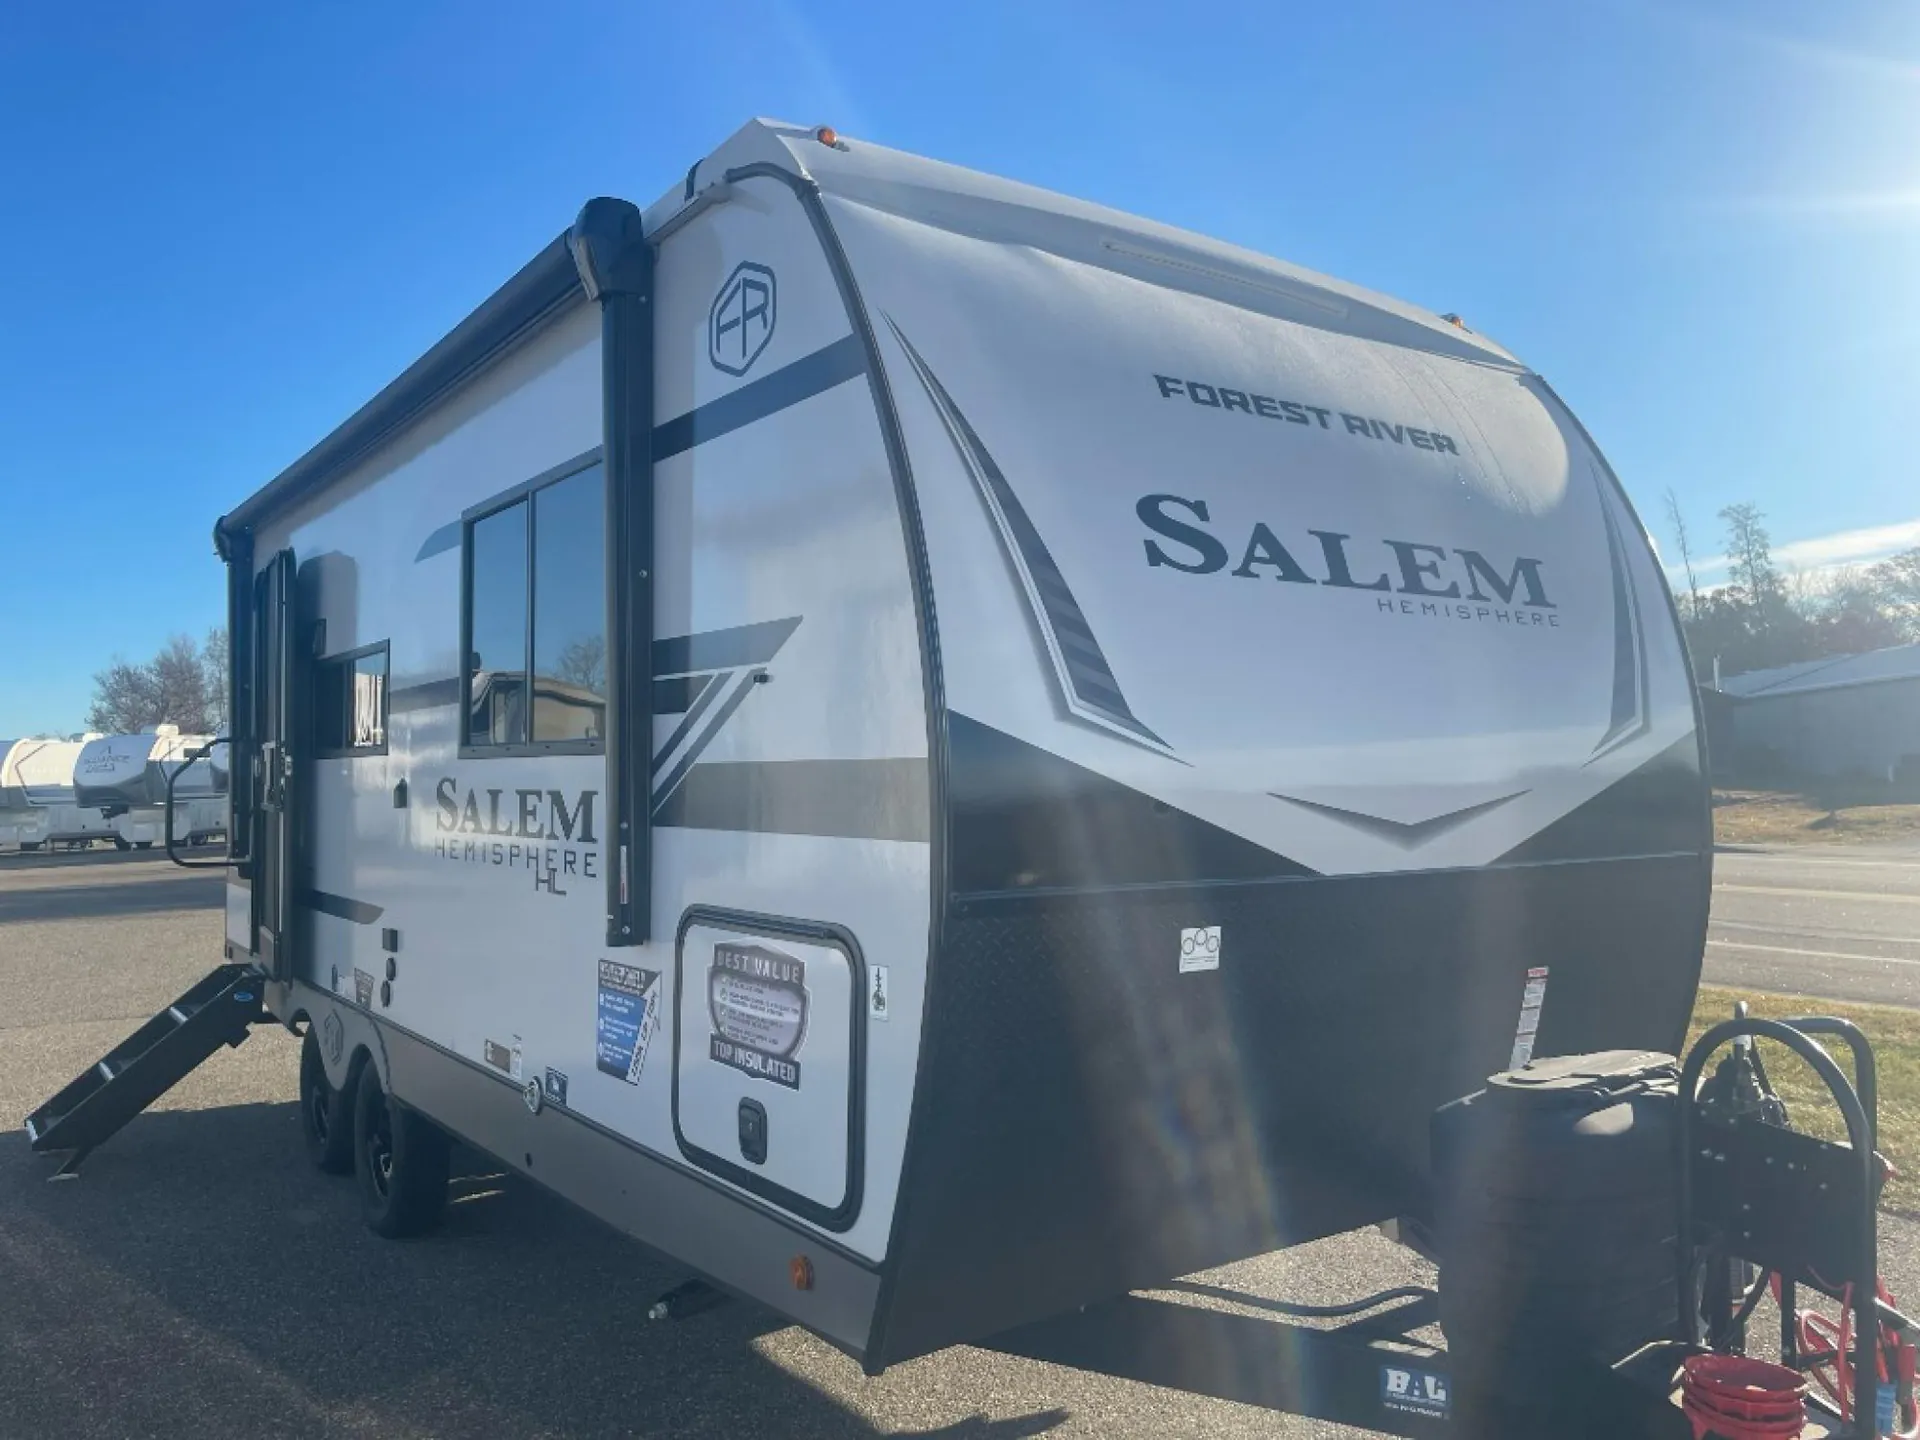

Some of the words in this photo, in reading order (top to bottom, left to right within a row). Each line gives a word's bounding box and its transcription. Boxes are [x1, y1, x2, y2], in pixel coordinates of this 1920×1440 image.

[1152, 373, 1332, 430] FOREST
[1340, 413, 1460, 456] RIVER
[1376, 597, 1561, 628] HEMISPHERE
[434, 836, 598, 879] HEMISPHERE
[534, 868, 567, 896] HL
[716, 948, 749, 973] BEST
[755, 956, 800, 984] VALUE
[713, 1040, 733, 1061] TOP
[734, 1047, 796, 1083] INSULATED
